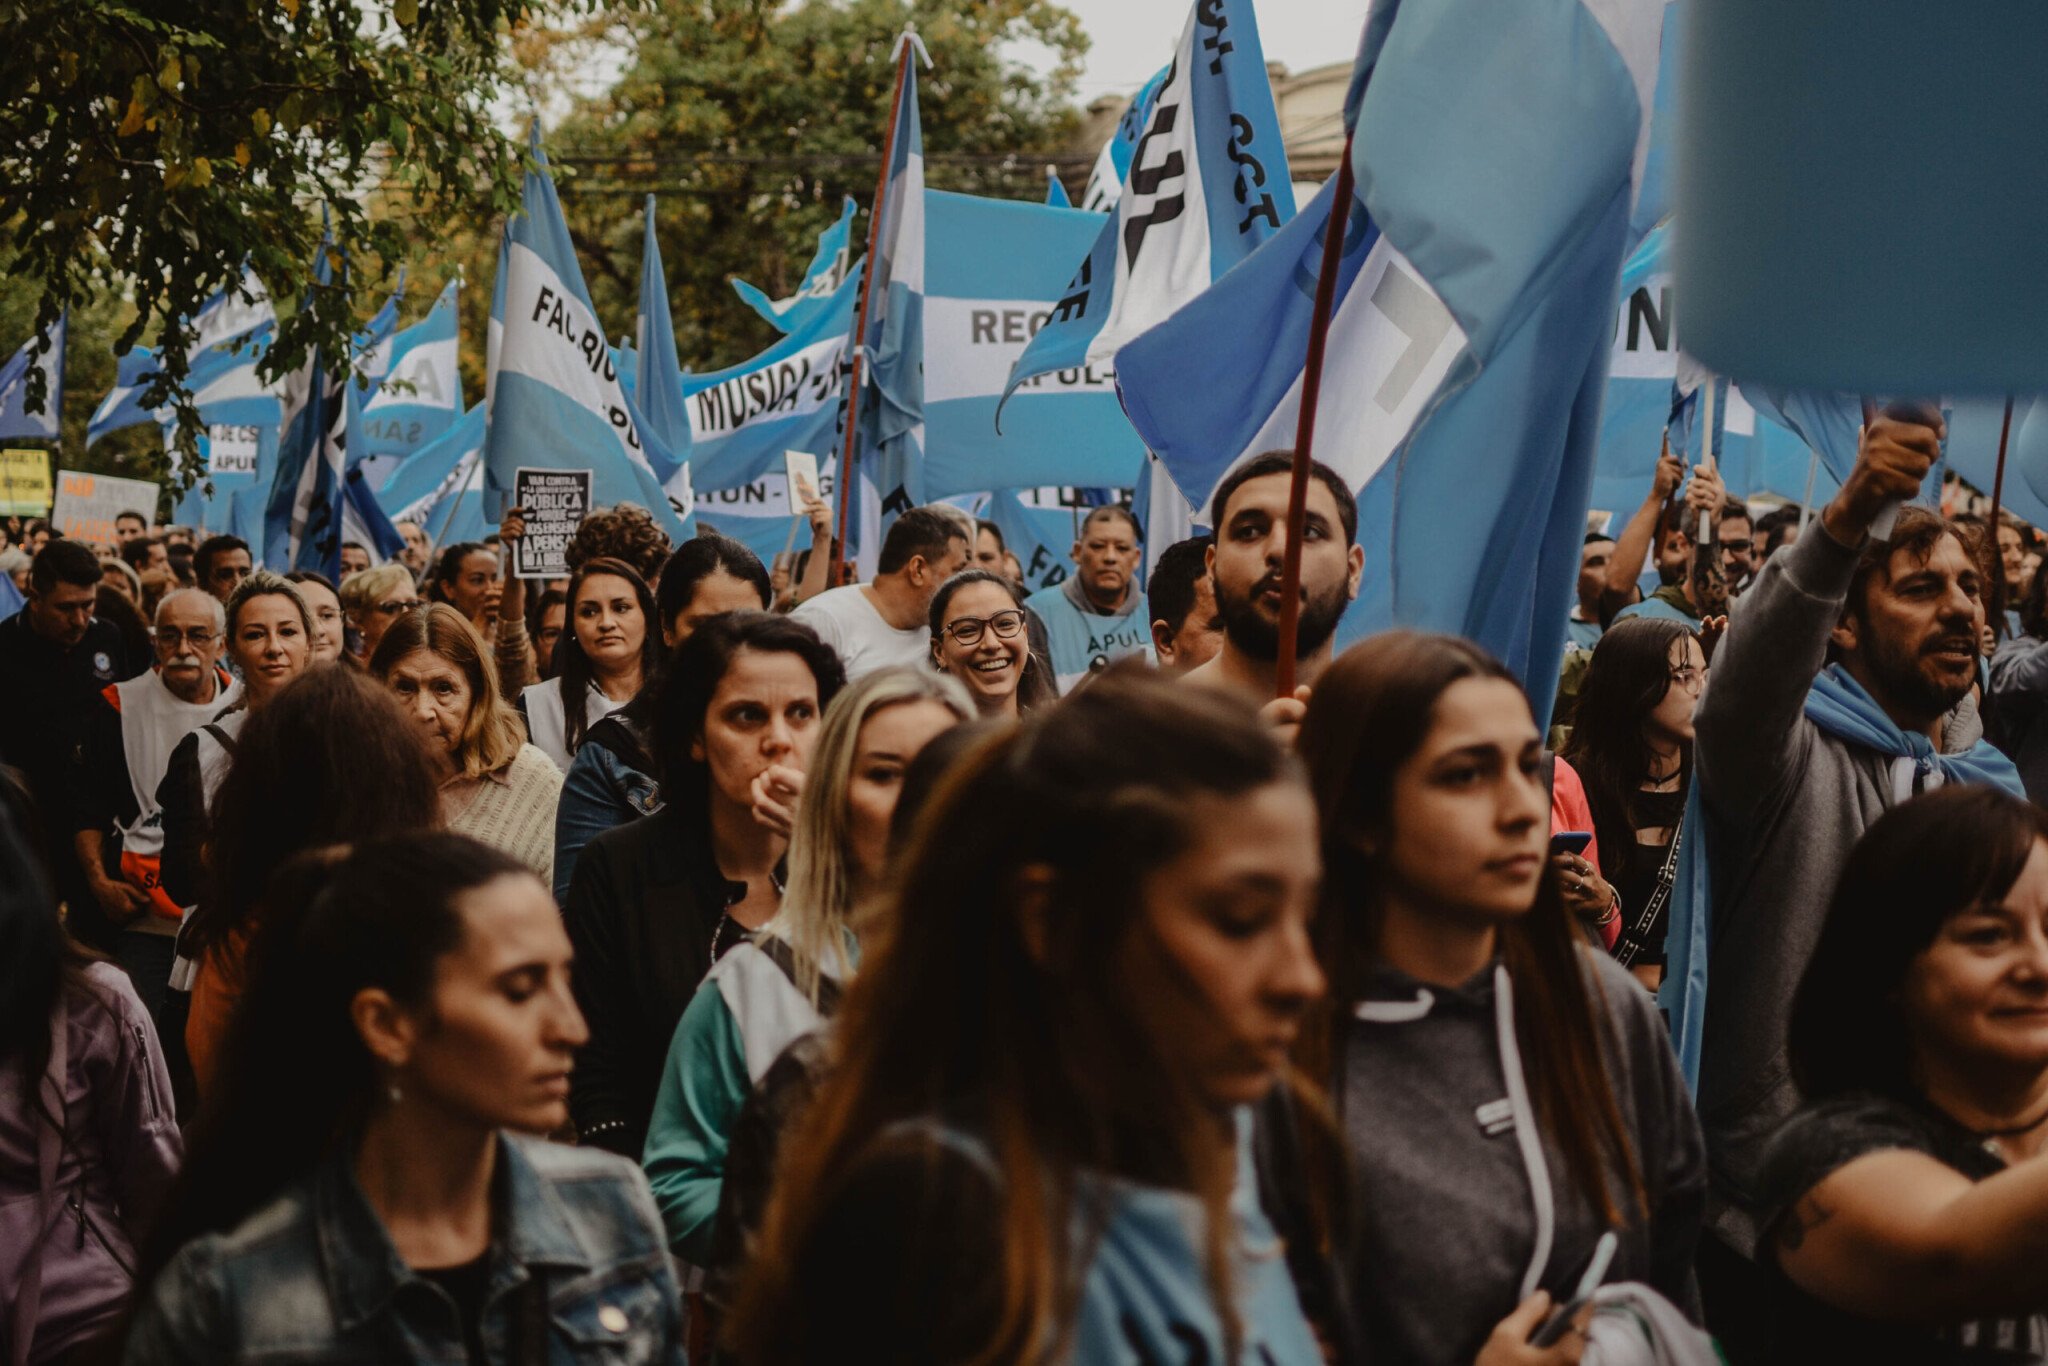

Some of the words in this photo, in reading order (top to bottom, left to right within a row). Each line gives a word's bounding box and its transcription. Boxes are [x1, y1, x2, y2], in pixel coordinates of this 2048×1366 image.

[528, 475, 545, 486] VAN
[546, 476, 577, 486] CONTRA
[526, 486, 535, 494] LA
[1087, 629, 1147, 654] APUL
